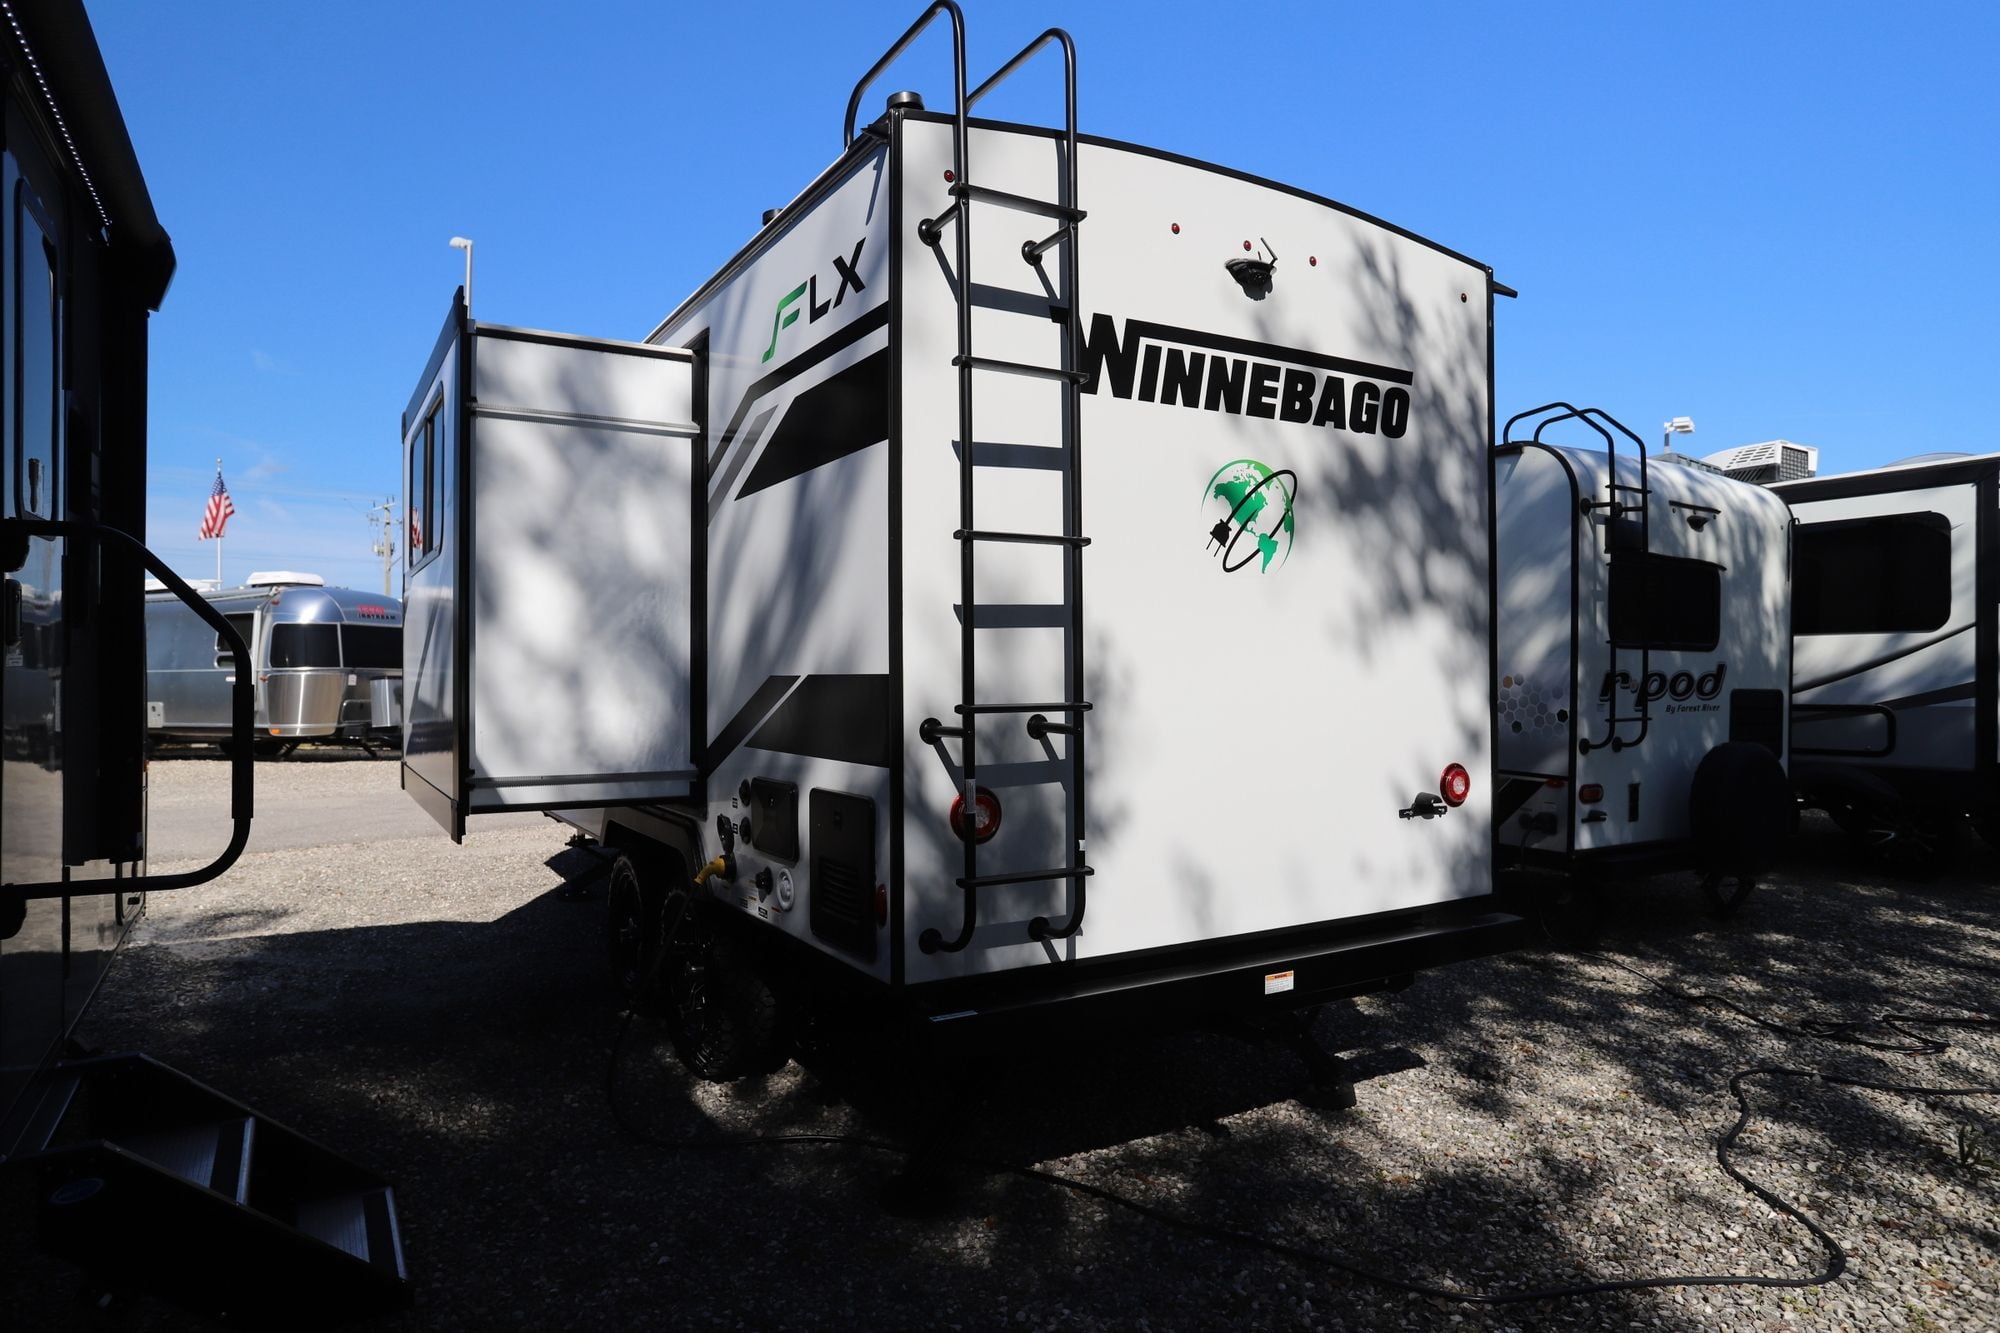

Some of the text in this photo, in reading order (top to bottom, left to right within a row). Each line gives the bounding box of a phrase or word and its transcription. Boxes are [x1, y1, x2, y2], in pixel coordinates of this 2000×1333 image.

[762, 236, 866, 363] FLX
[1050, 306, 1414, 439] WINNEBAGO
[1677, 704, 1701, 712] Forest
